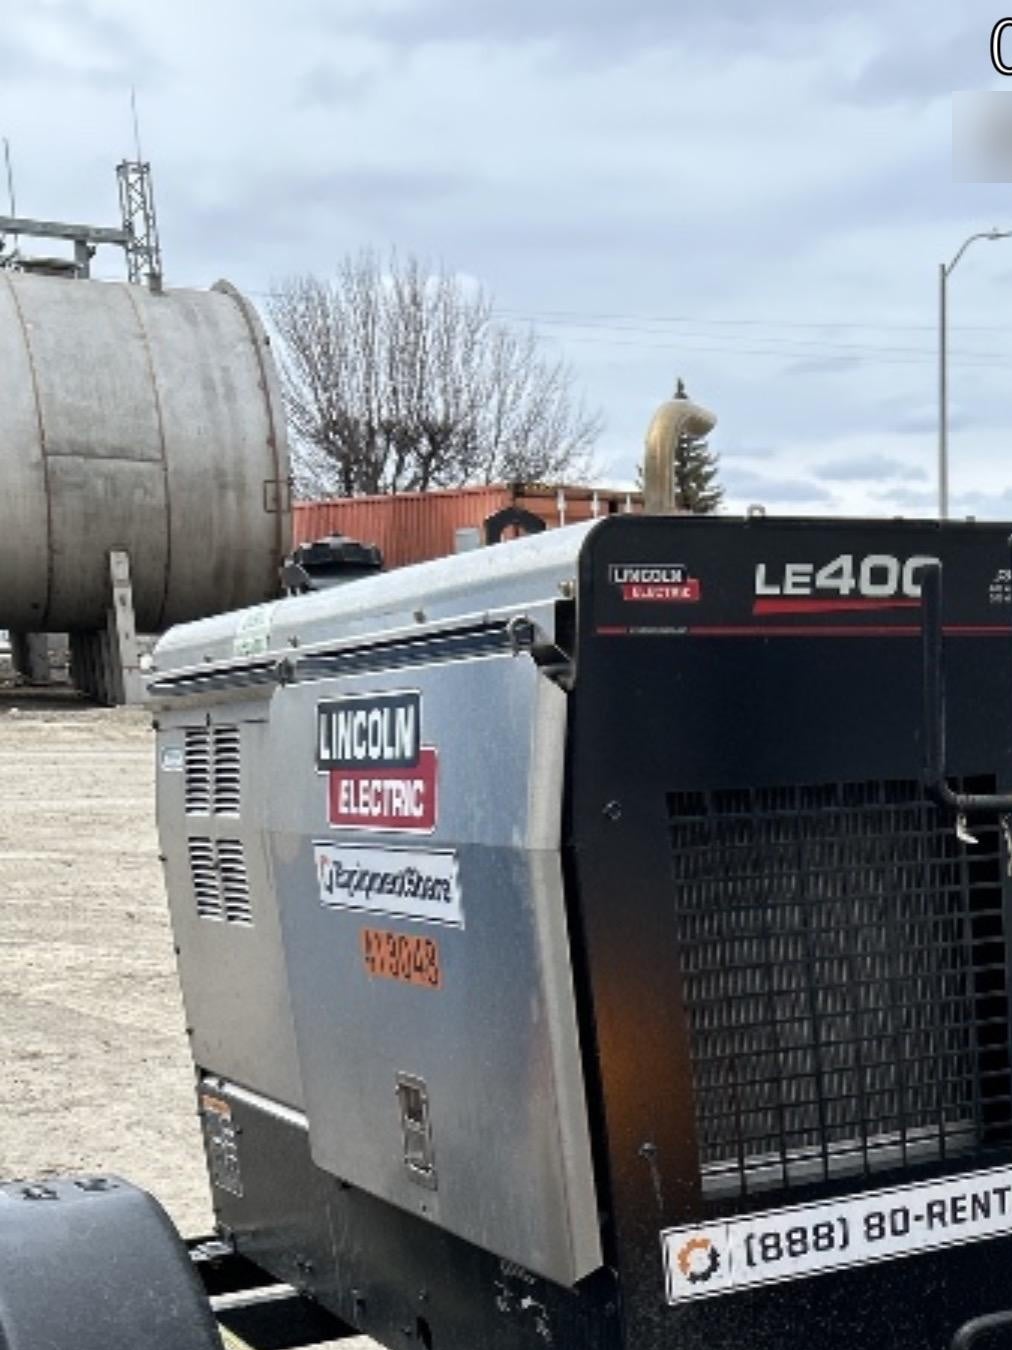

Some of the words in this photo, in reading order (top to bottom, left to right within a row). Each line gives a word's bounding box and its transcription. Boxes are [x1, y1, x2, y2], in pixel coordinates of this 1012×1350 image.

[613, 568, 682, 584] LINCOLN
[631, 587, 692, 599] ELECTRIC
[319, 704, 415, 760] LINCOLN
[338, 779, 424, 817] ELECTRIC
[744, 1216, 850, 1267] (888)
